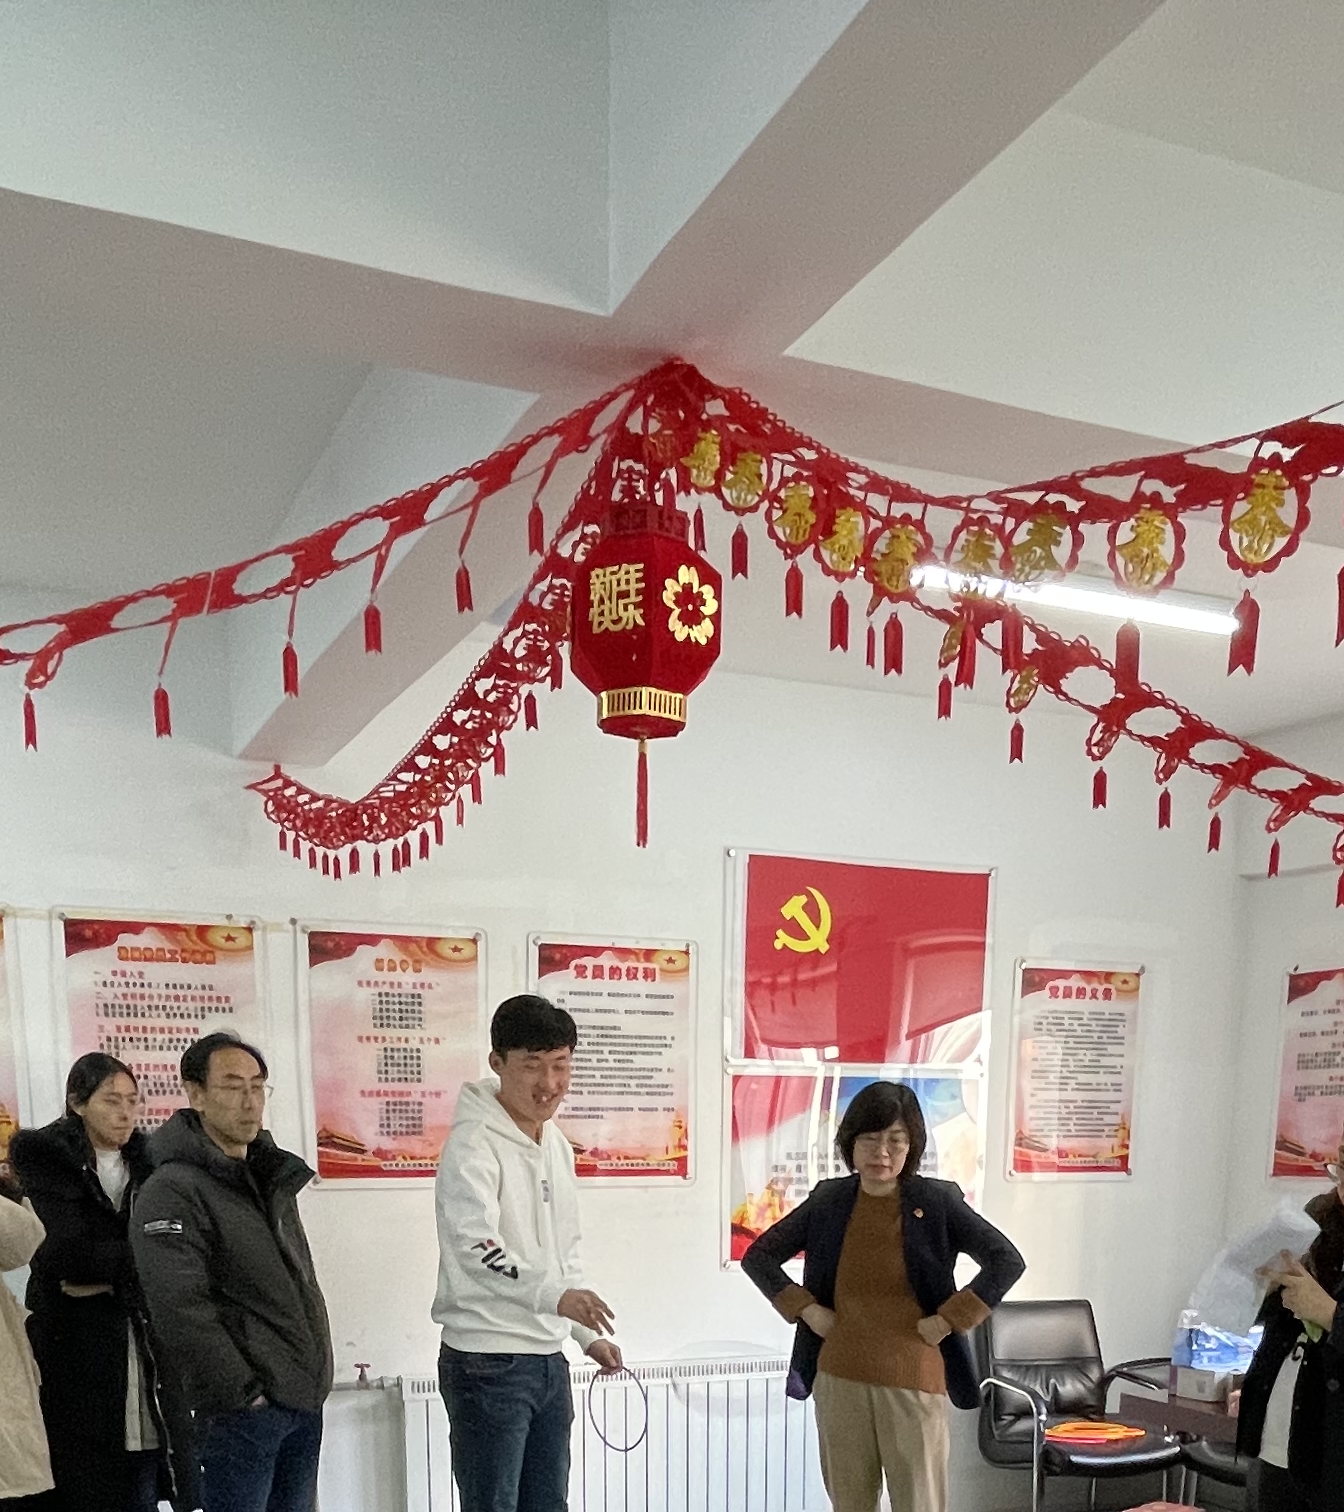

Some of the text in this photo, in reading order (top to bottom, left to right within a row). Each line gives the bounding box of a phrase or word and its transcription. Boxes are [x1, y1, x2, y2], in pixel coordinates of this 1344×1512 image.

[589, 563, 646, 604] 新年
[589, 599, 646, 634] 快乐
[574, 964, 657, 982] 党员的权利
[1048, 985, 1114, 1001] 党员的义务
